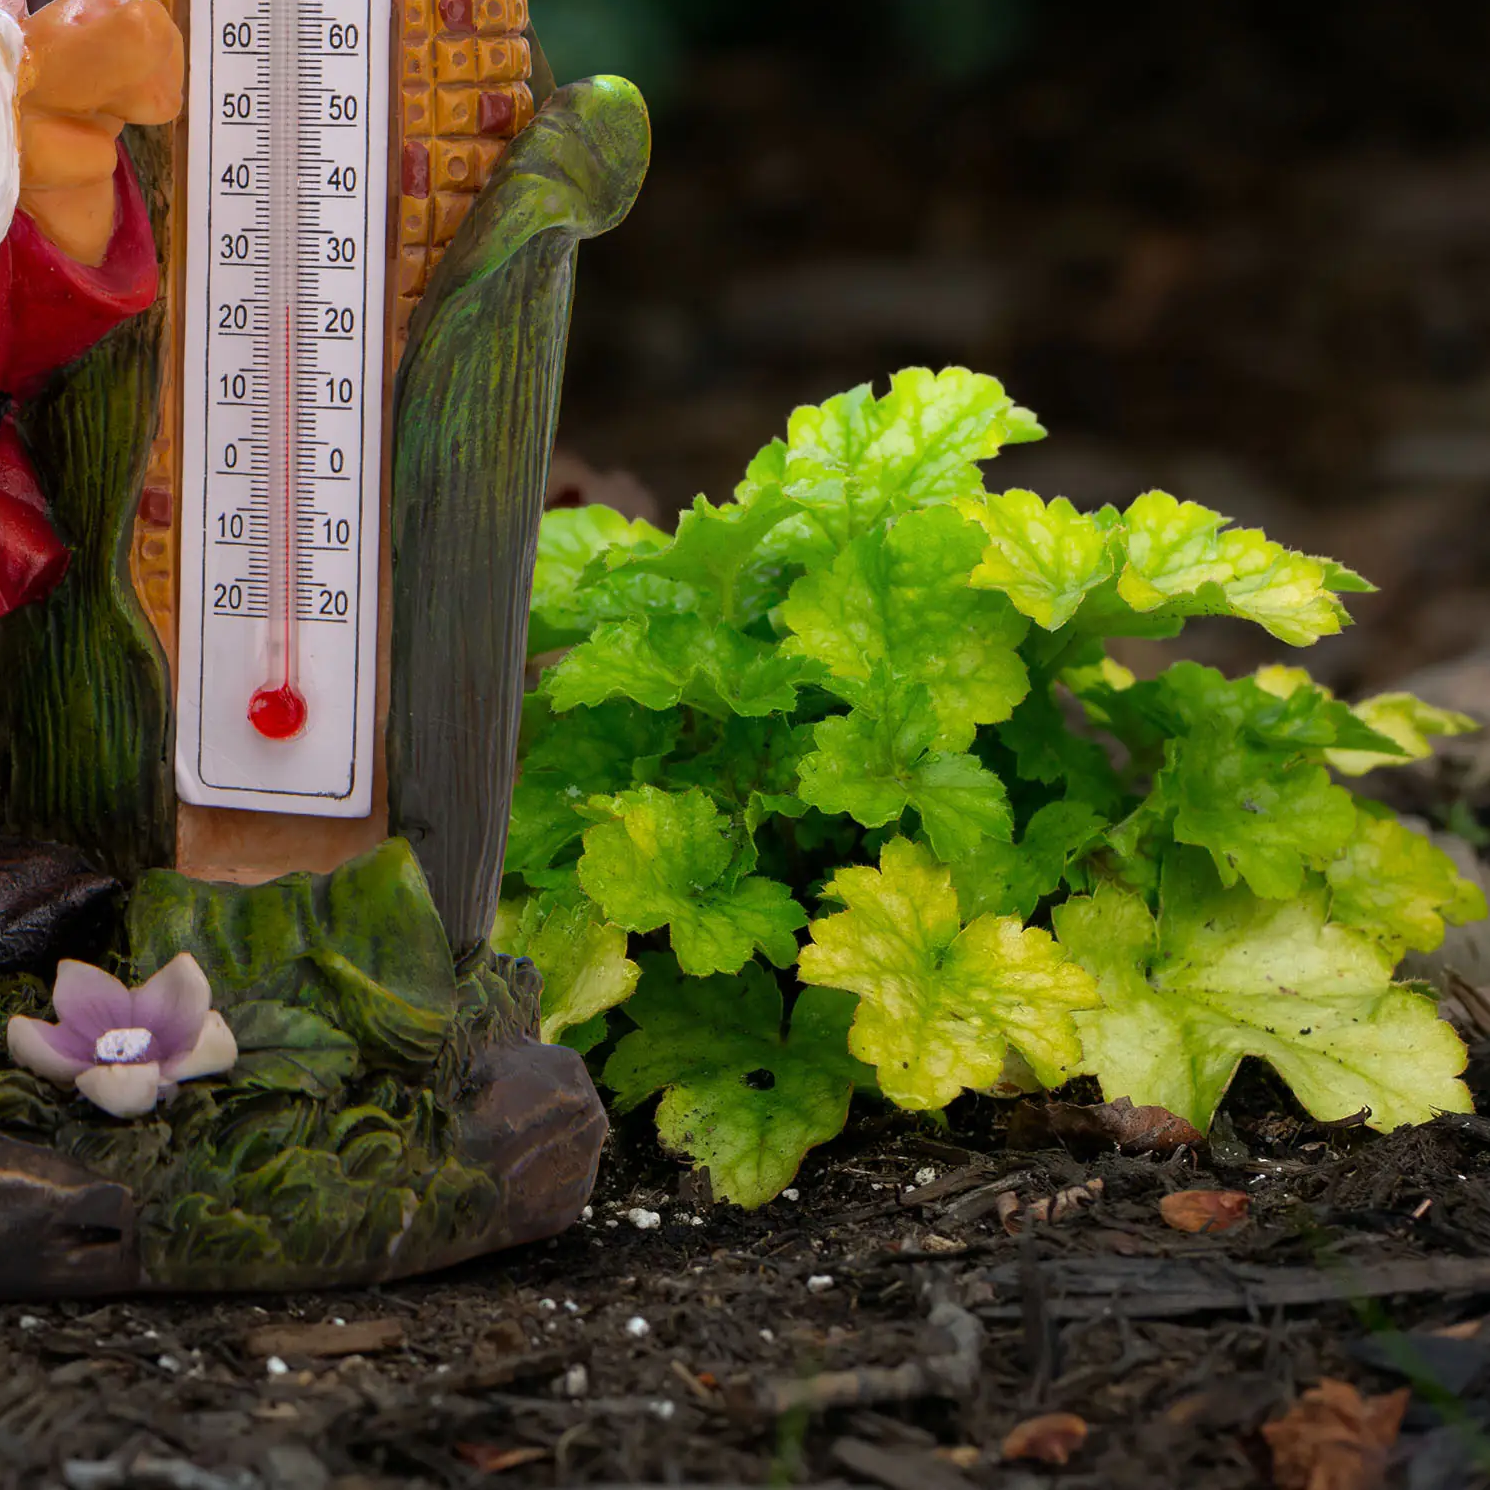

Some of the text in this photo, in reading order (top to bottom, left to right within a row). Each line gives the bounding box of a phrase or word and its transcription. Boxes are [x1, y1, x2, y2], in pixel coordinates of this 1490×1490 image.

[222, 21, 252, 49] 60
[329, 23, 359, 50] 60
[222, 92, 251, 119] 50
[328, 94, 358, 122] 50
[220, 163, 250, 190] 40
[326, 165, 357, 193] 40
[220, 233, 250, 260] 30
[326, 236, 356, 263] 30
[218, 303, 248, 330] 20
[324, 307, 355, 334] 20
[219, 373, 247, 400] 10
[325, 377, 353, 404] 10
[224, 442, 238, 469] 0
[329, 447, 345, 474] 0
[217, 512, 244, 539] 10
[322, 517, 350, 545] 10
[213, 582, 243, 610] 20
[318, 589, 349, 617] 20
